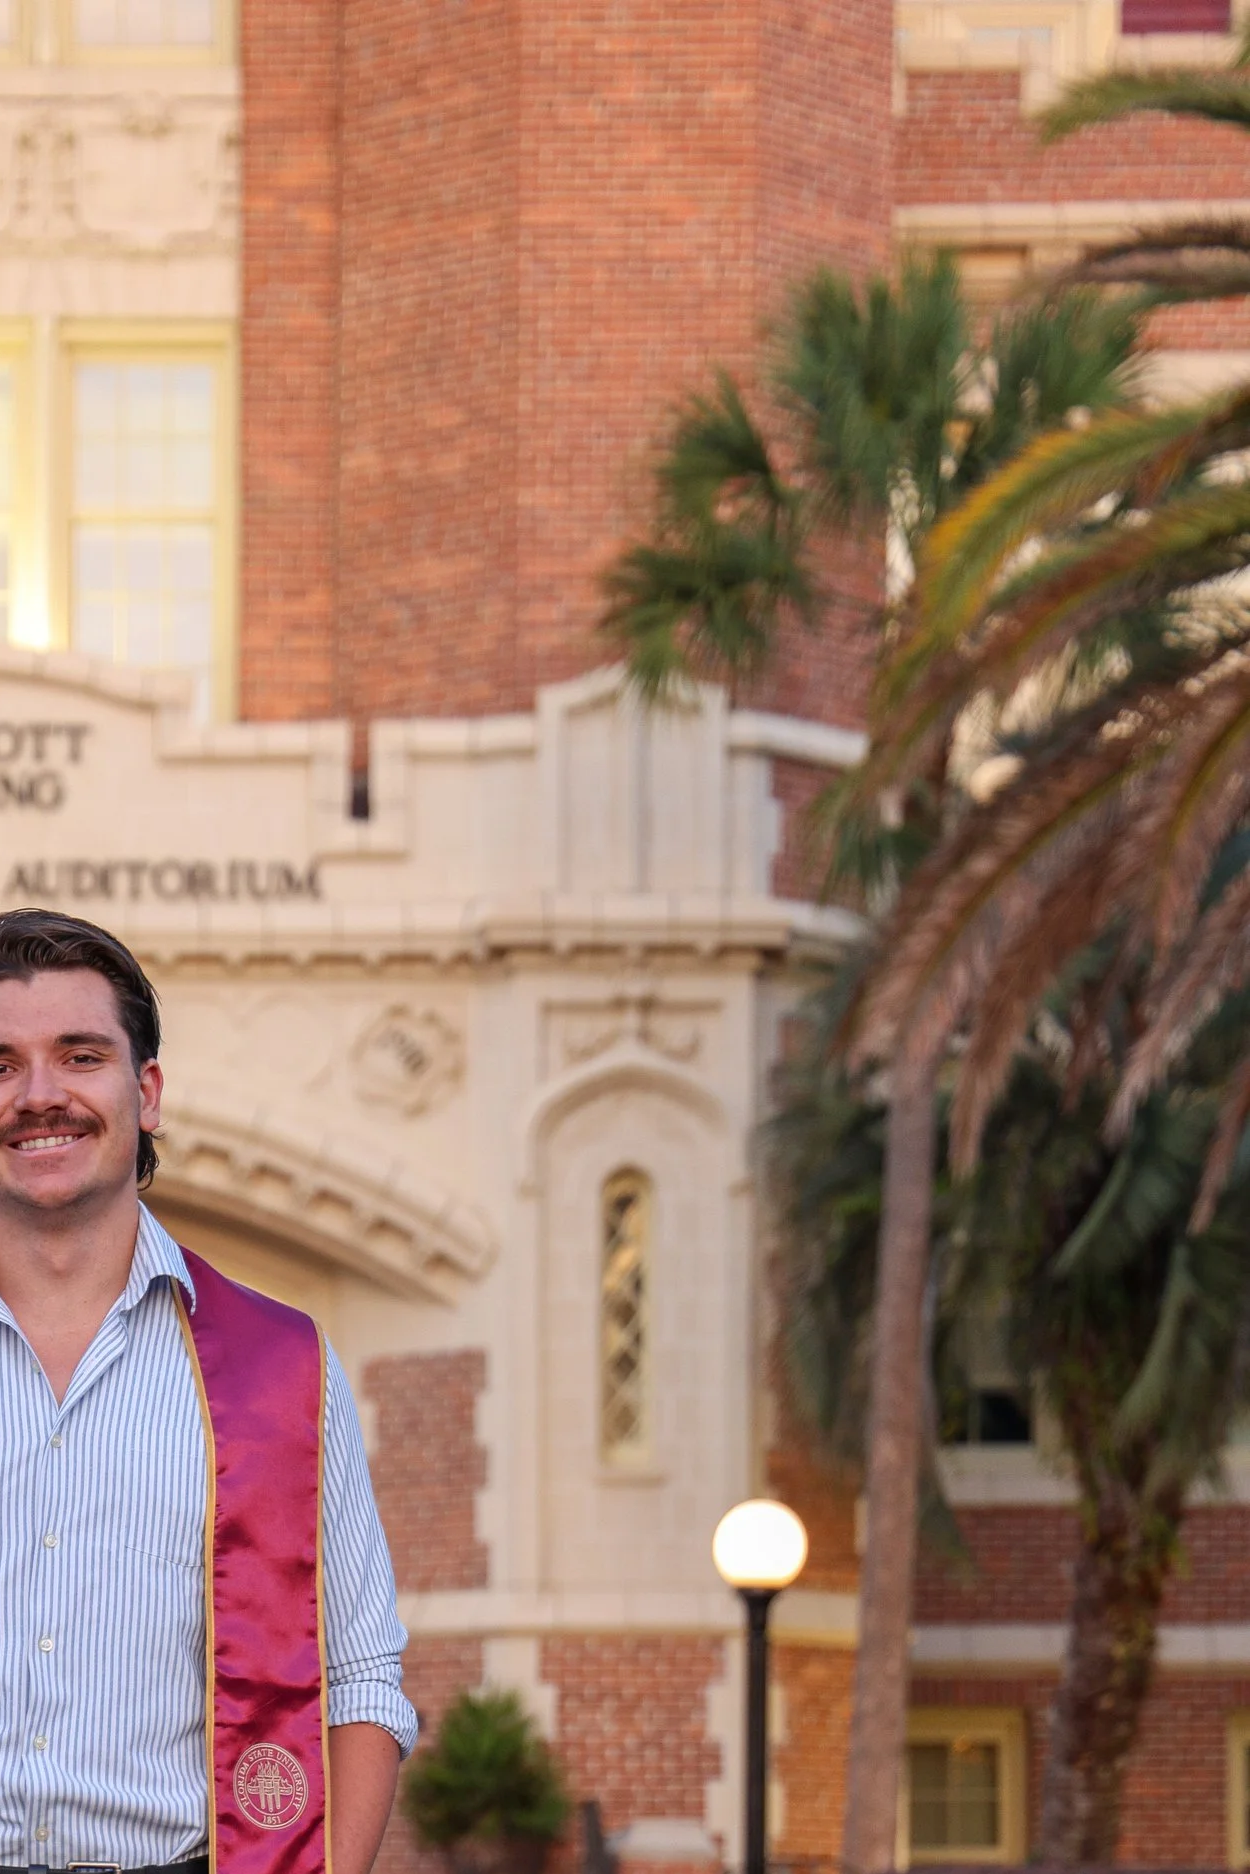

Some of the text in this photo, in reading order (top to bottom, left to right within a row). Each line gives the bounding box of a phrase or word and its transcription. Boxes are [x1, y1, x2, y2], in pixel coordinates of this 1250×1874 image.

[3, 858, 325, 902] AUDITORIUM
[238, 1748, 303, 1809] FLORIDA STATE UNIVERSITY
[263, 1816, 281, 1824] 1851
